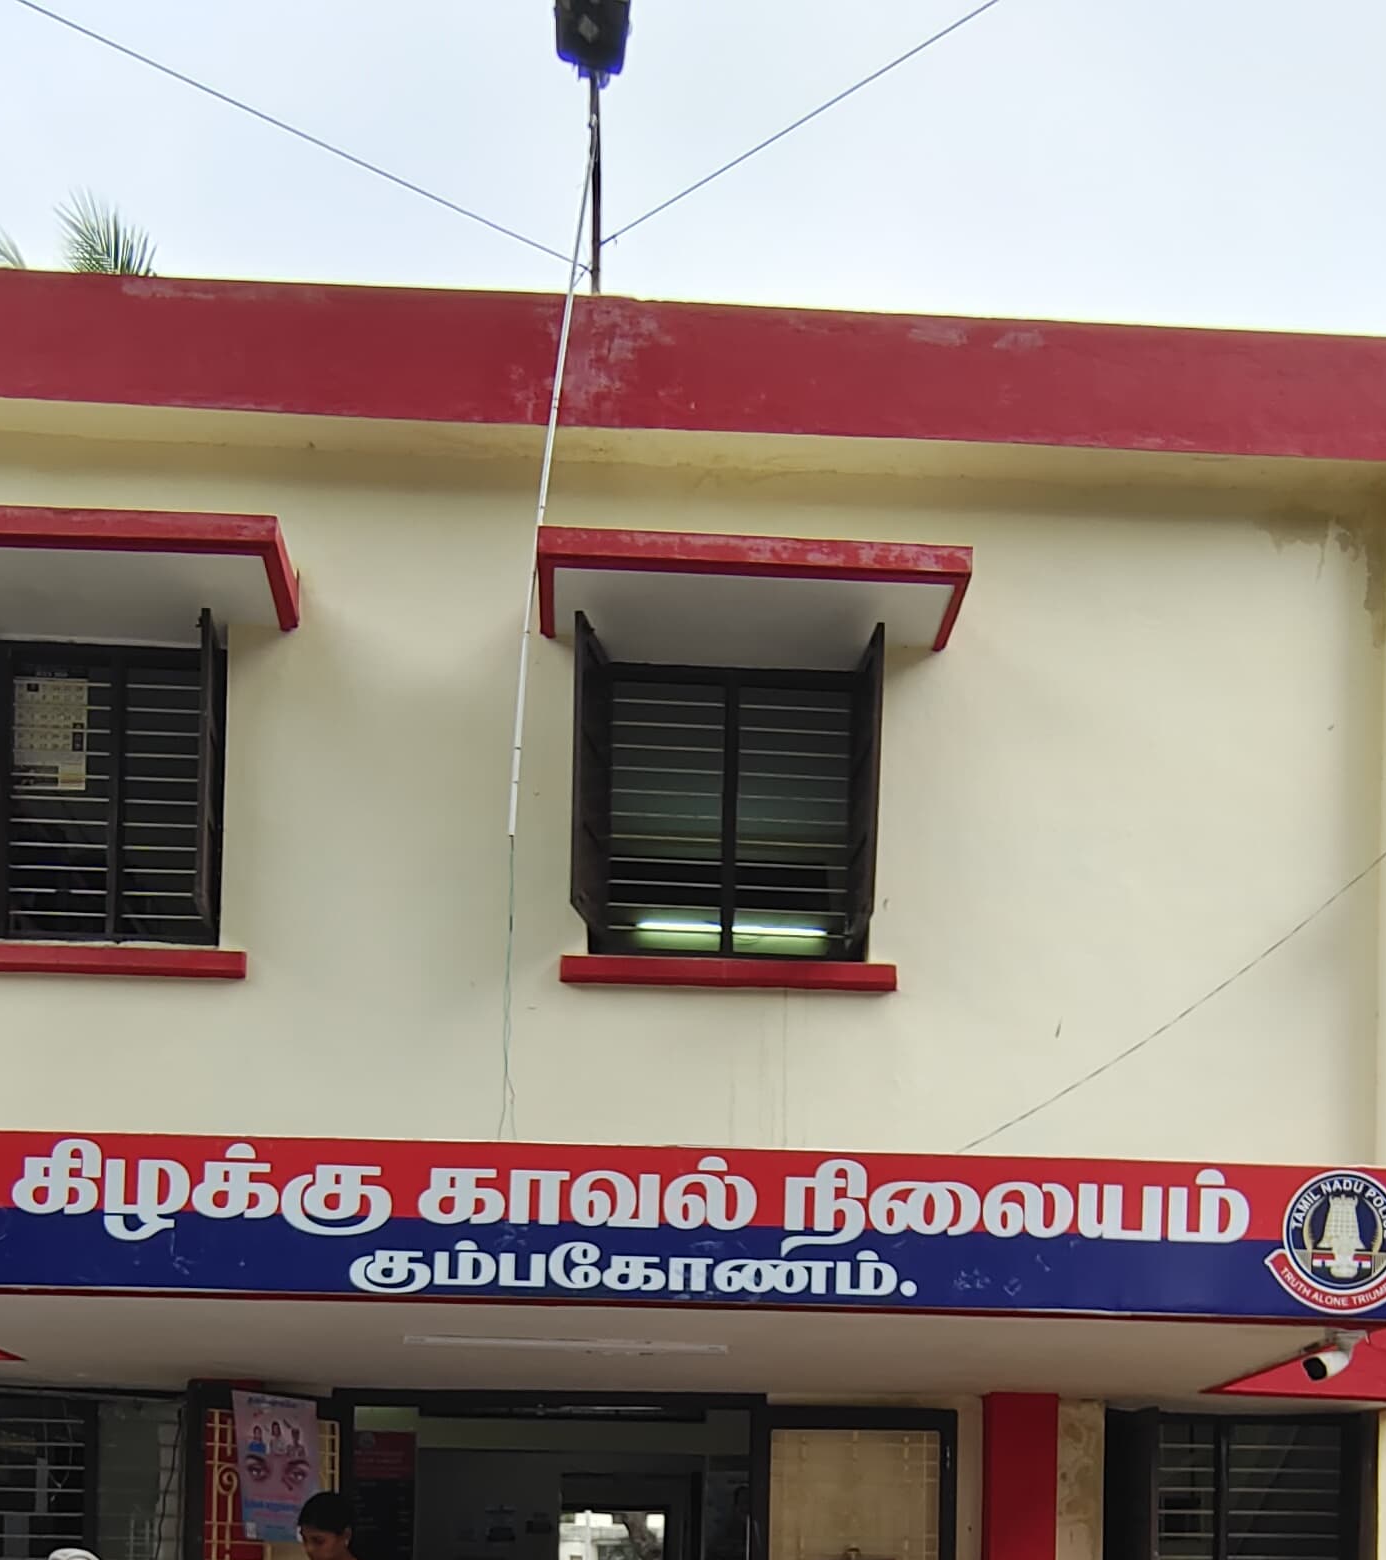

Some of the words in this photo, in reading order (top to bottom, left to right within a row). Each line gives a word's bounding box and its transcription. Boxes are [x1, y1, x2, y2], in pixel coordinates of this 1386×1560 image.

[12, 1138, 392, 1241] கிழக்கு
[418, 1156, 757, 1230] காவல்
[781, 1158, 1250, 1257] நிலையம்
[1290, 1188, 1322, 1231] TAMIL
[1320, 1178, 1364, 1194] NADU
[349, 1241, 917, 1297] கும்பகோணம்.
[1280, 1266, 1312, 1297] TRUTH
[1311, 1293, 1350, 1307] ALONE
